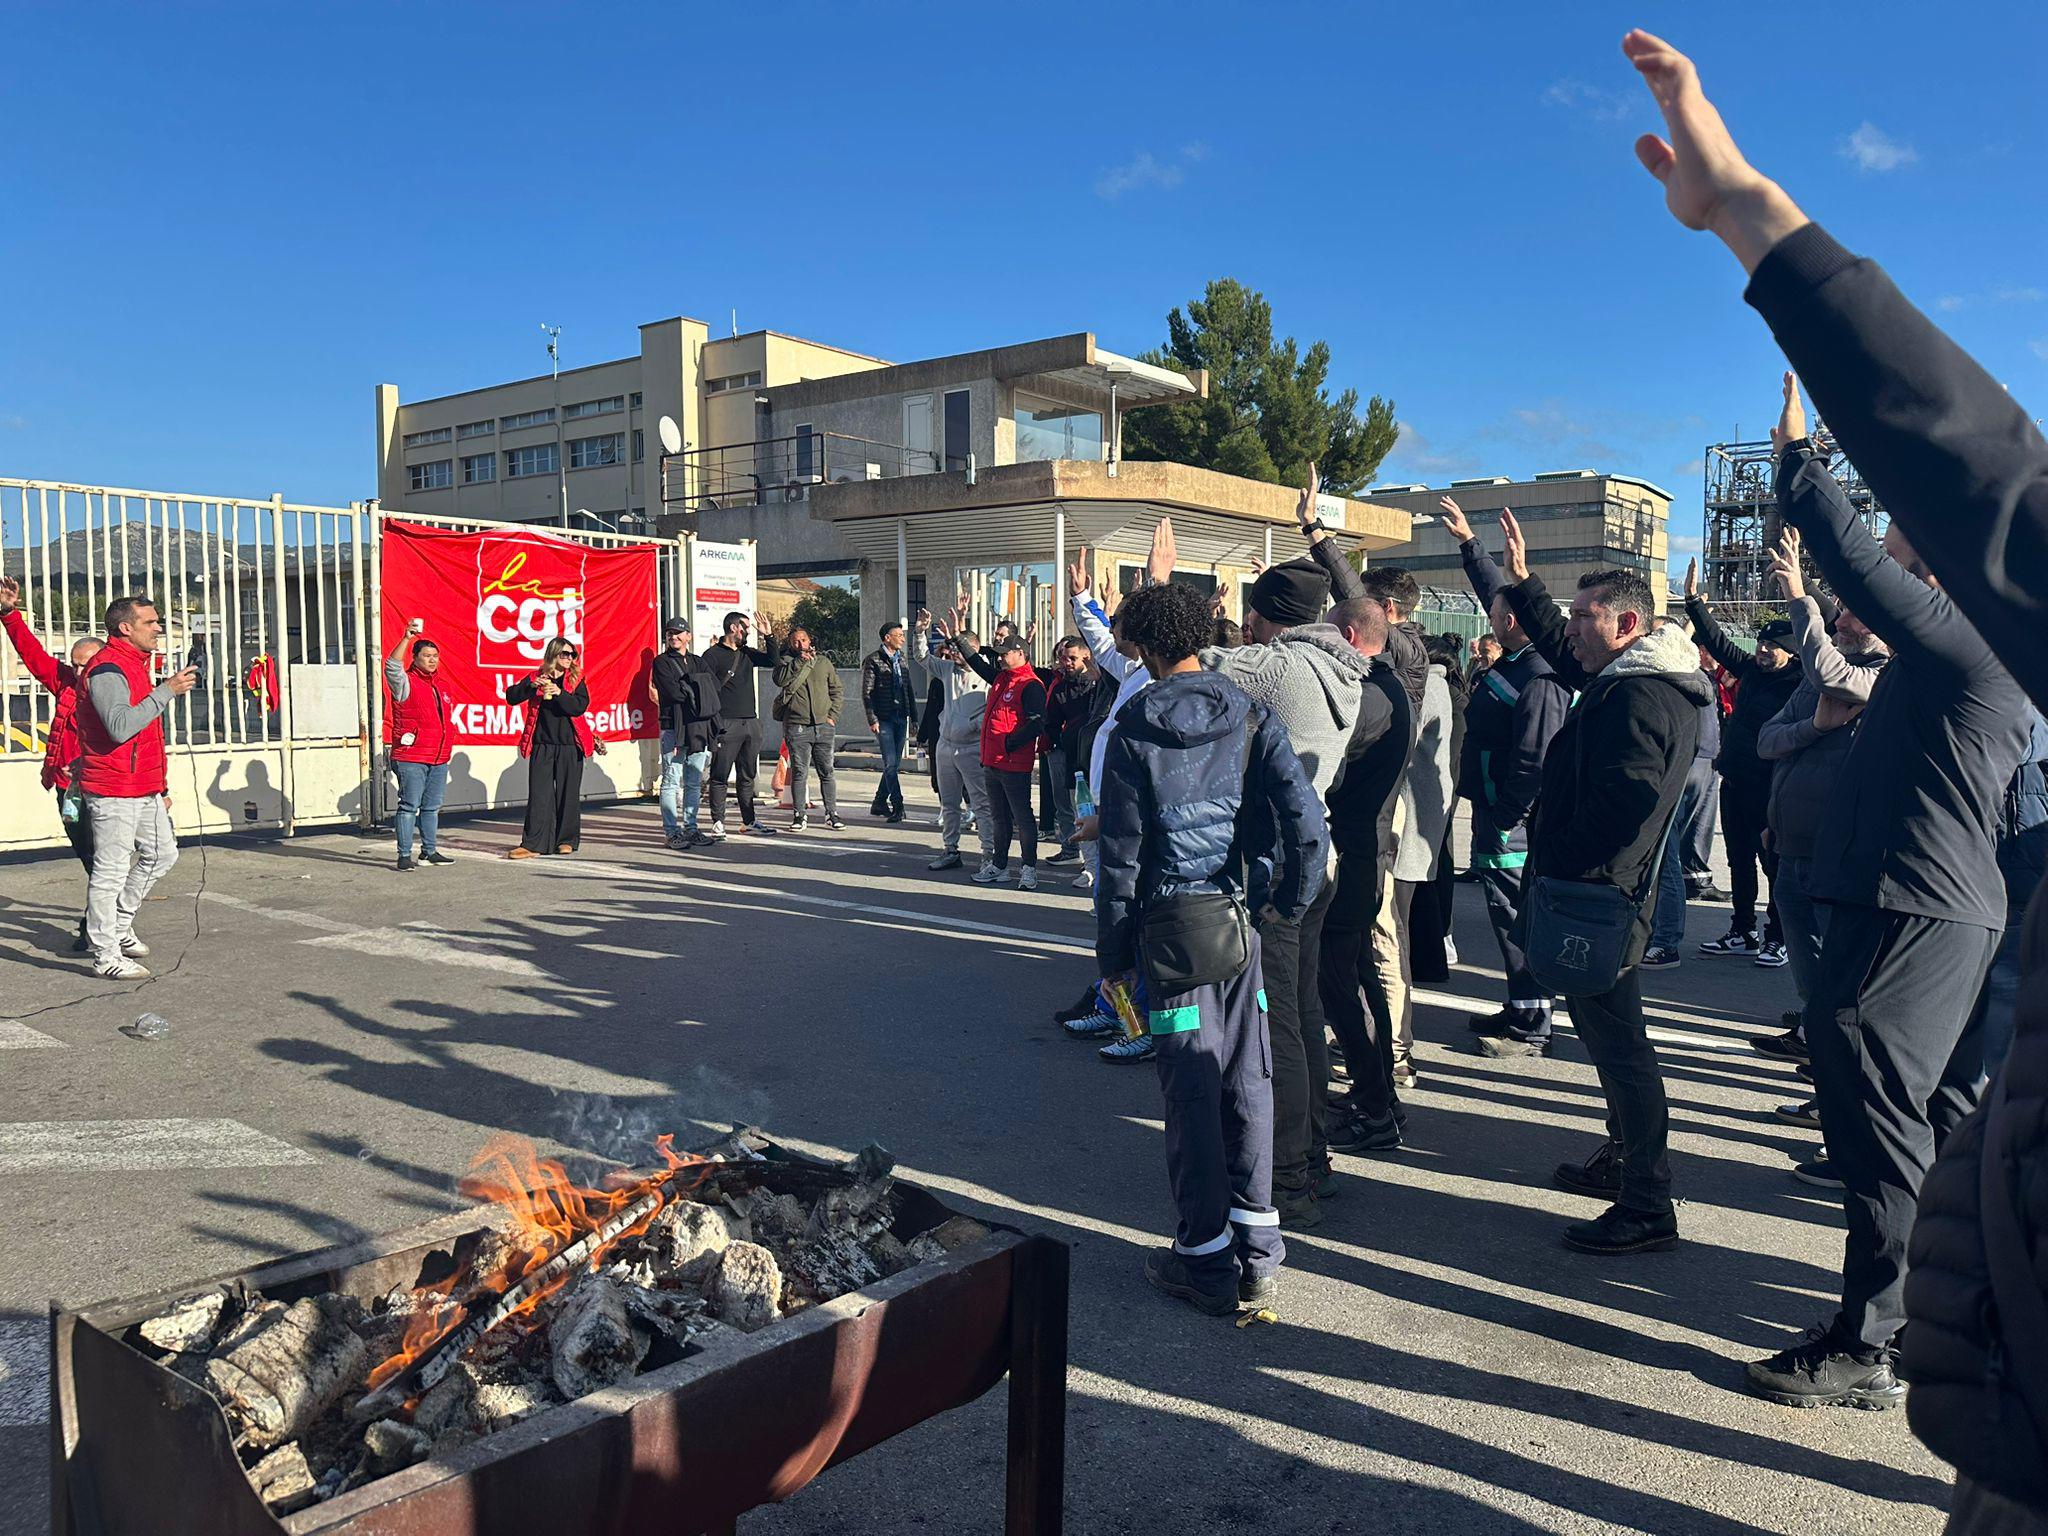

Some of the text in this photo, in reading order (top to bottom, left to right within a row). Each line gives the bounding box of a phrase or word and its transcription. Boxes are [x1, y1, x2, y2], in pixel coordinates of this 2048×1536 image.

[1317, 504, 1339, 518] KEMA
[699, 549, 745, 562] ARKEMA
[483, 551, 583, 599] la
[479, 588, 584, 660] cgt
[450, 702, 644, 735] KEMA seille
